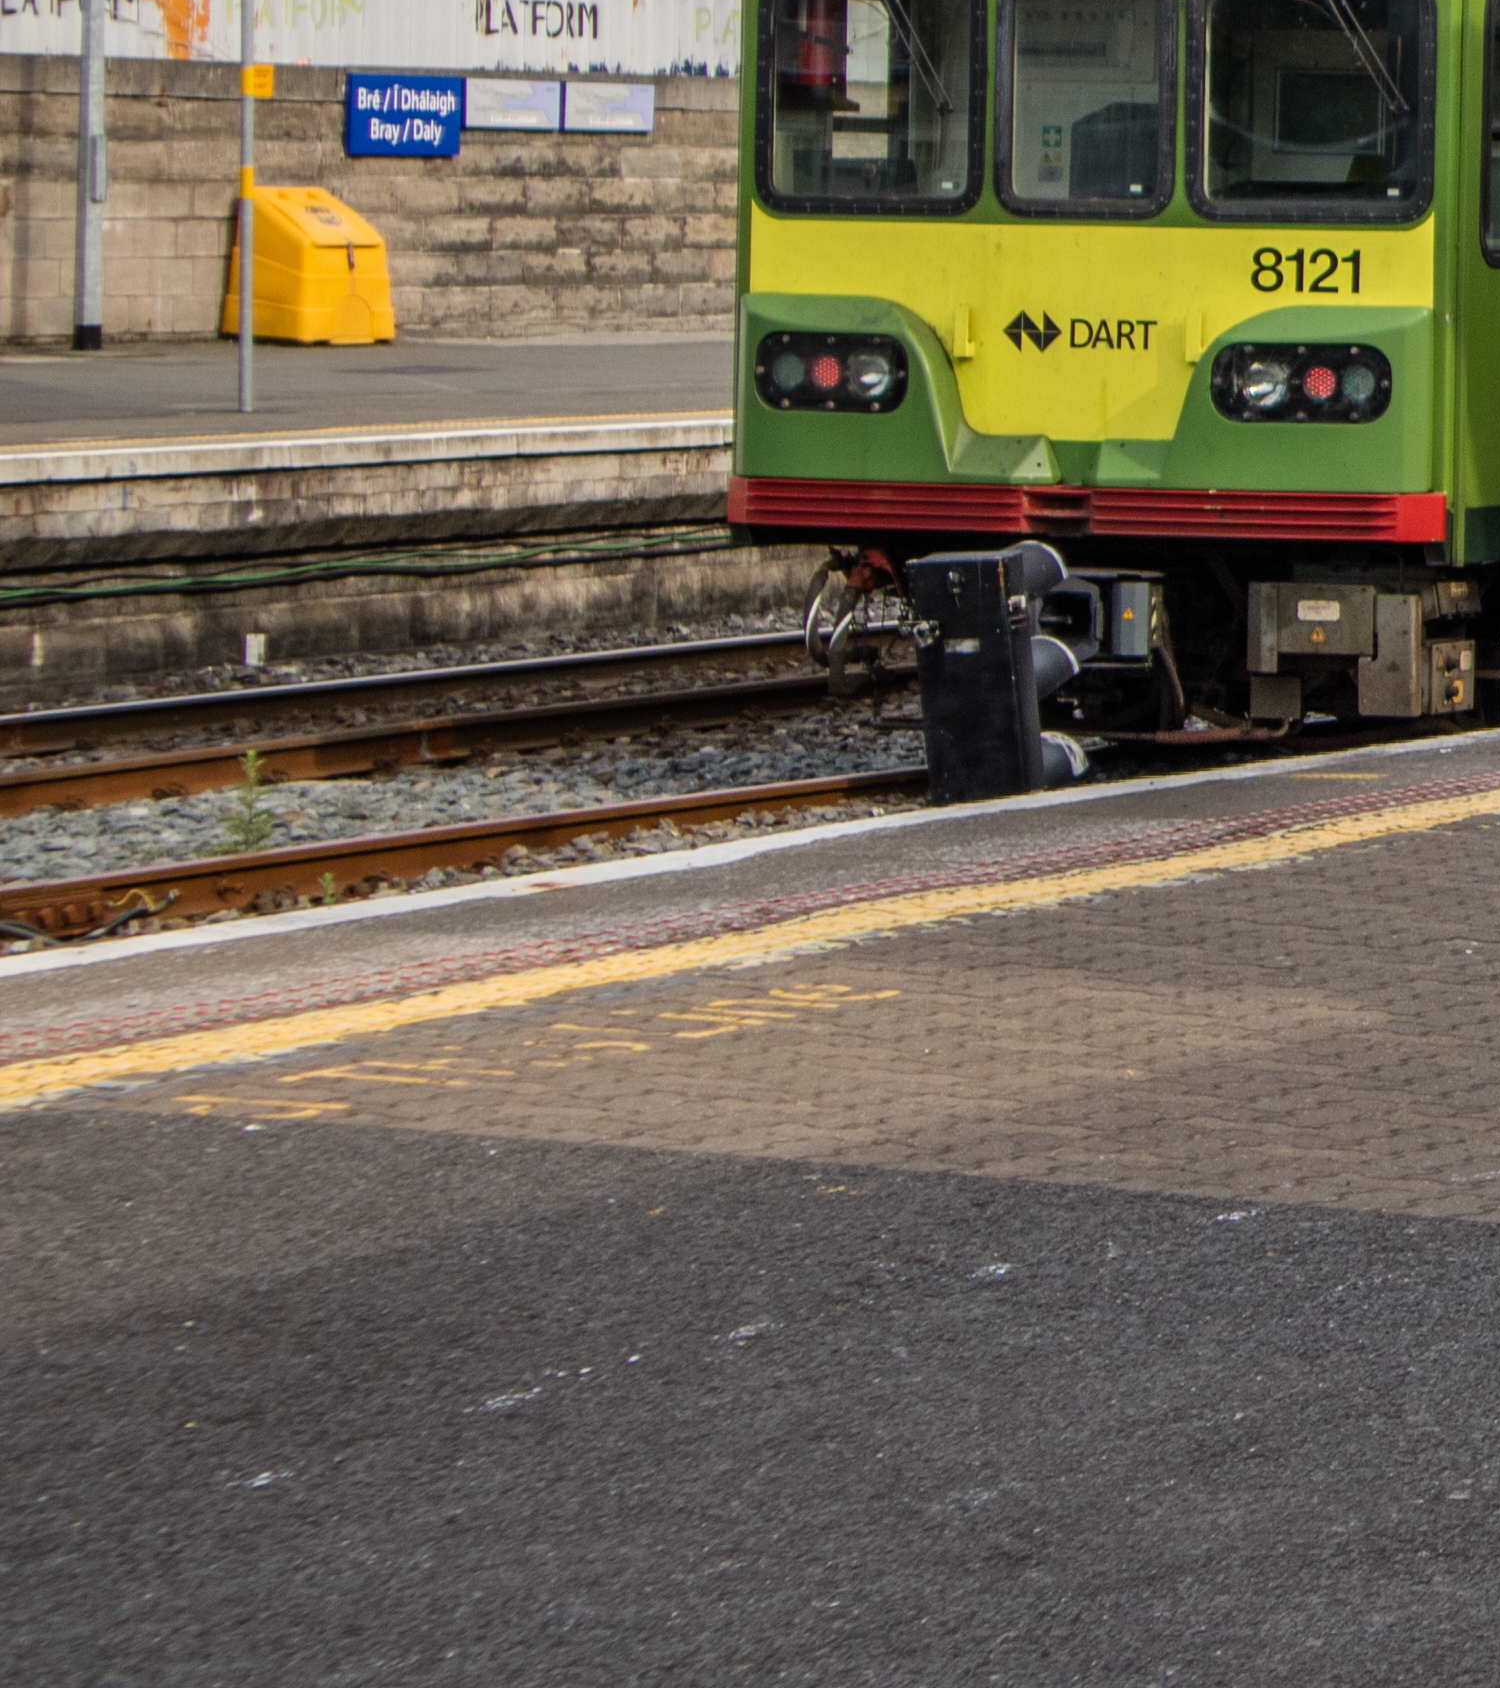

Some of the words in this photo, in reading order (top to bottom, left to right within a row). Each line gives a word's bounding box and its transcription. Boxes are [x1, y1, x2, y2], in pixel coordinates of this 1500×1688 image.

[357, 86, 380, 111] Bré
[402, 88, 456, 117] Dhálaigh
[370, 117, 400, 146] Bray
[412, 118, 442, 147] Daly
[1250, 246, 1362, 294] 8121
[1069, 318, 1158, 351] DART
